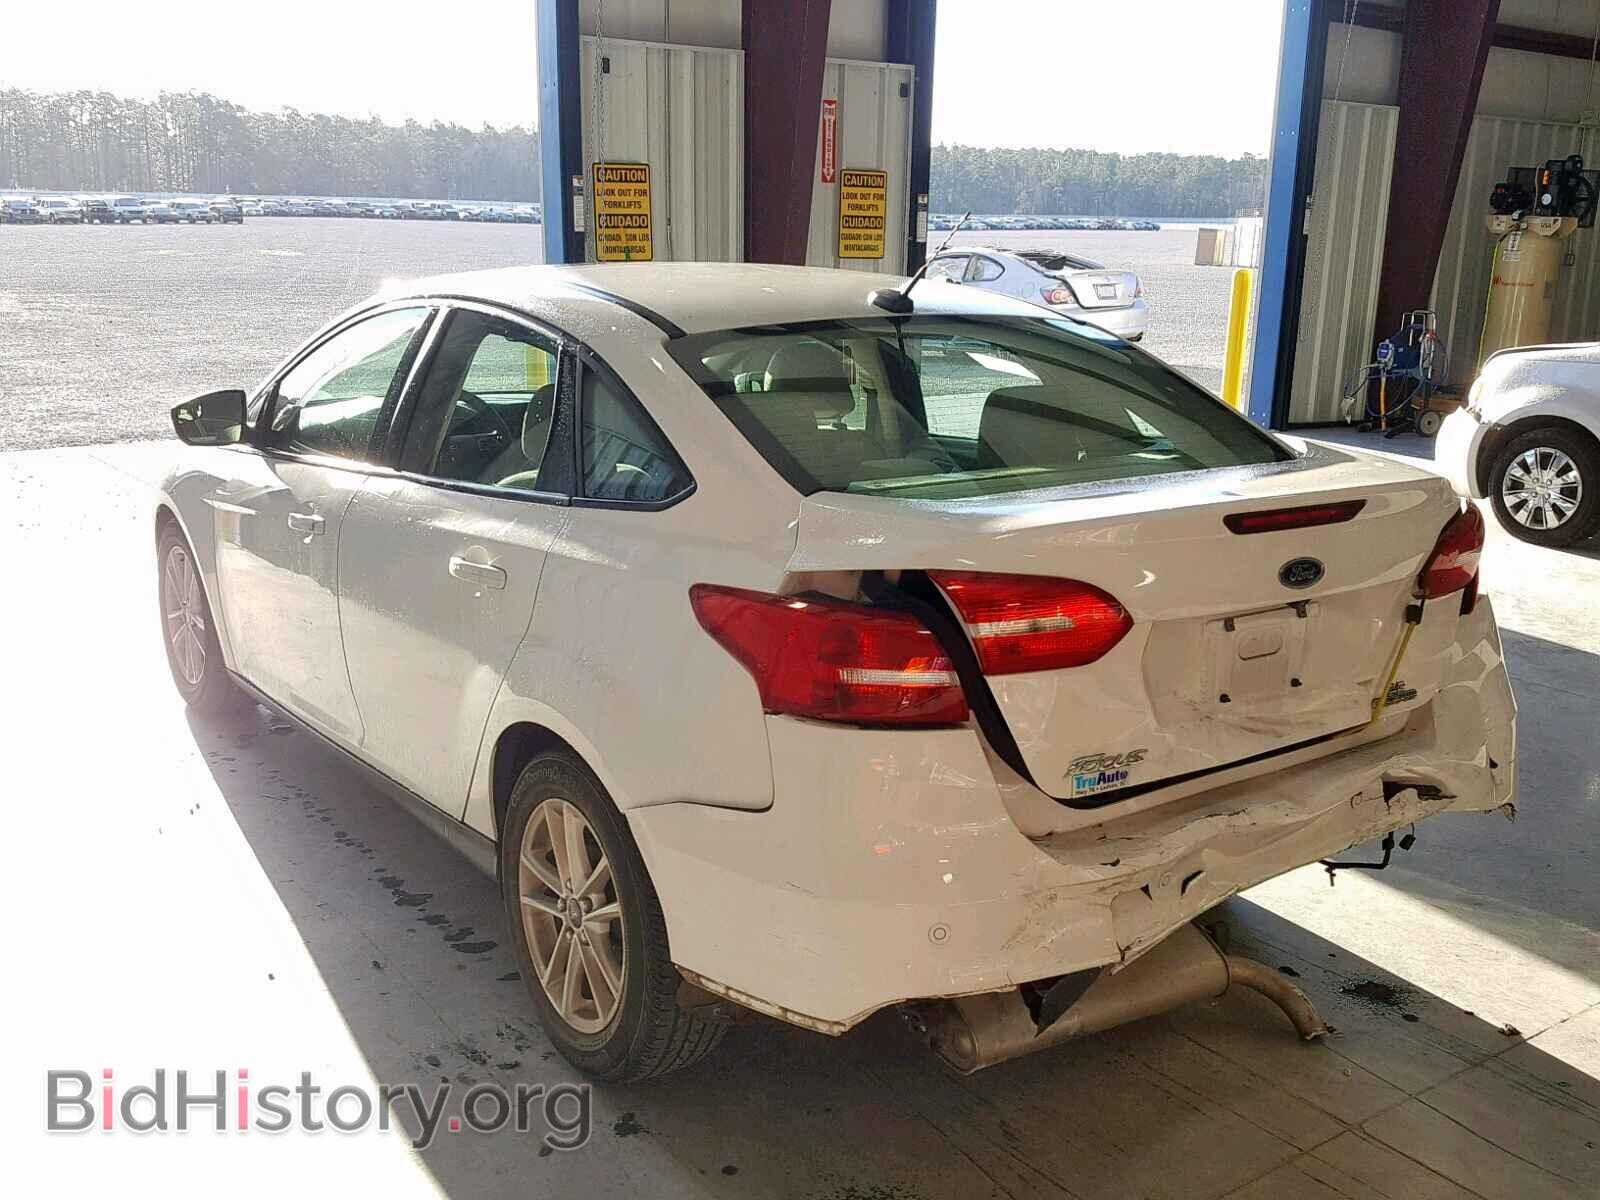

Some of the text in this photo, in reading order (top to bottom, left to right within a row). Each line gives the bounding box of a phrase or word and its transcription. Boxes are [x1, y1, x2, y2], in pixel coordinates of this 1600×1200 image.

[599, 169, 645, 181] CAUTION
[844, 175, 884, 187] CAUTION
[634, 189, 647, 197] FOR
[860, 192, 871, 201] OUT
[847, 203, 880, 211] FORKLIFTS
[600, 216, 647, 227] CUIDADO
[843, 216, 882, 228] CUIDADO
[1074, 770, 1128, 790] TruAuto
